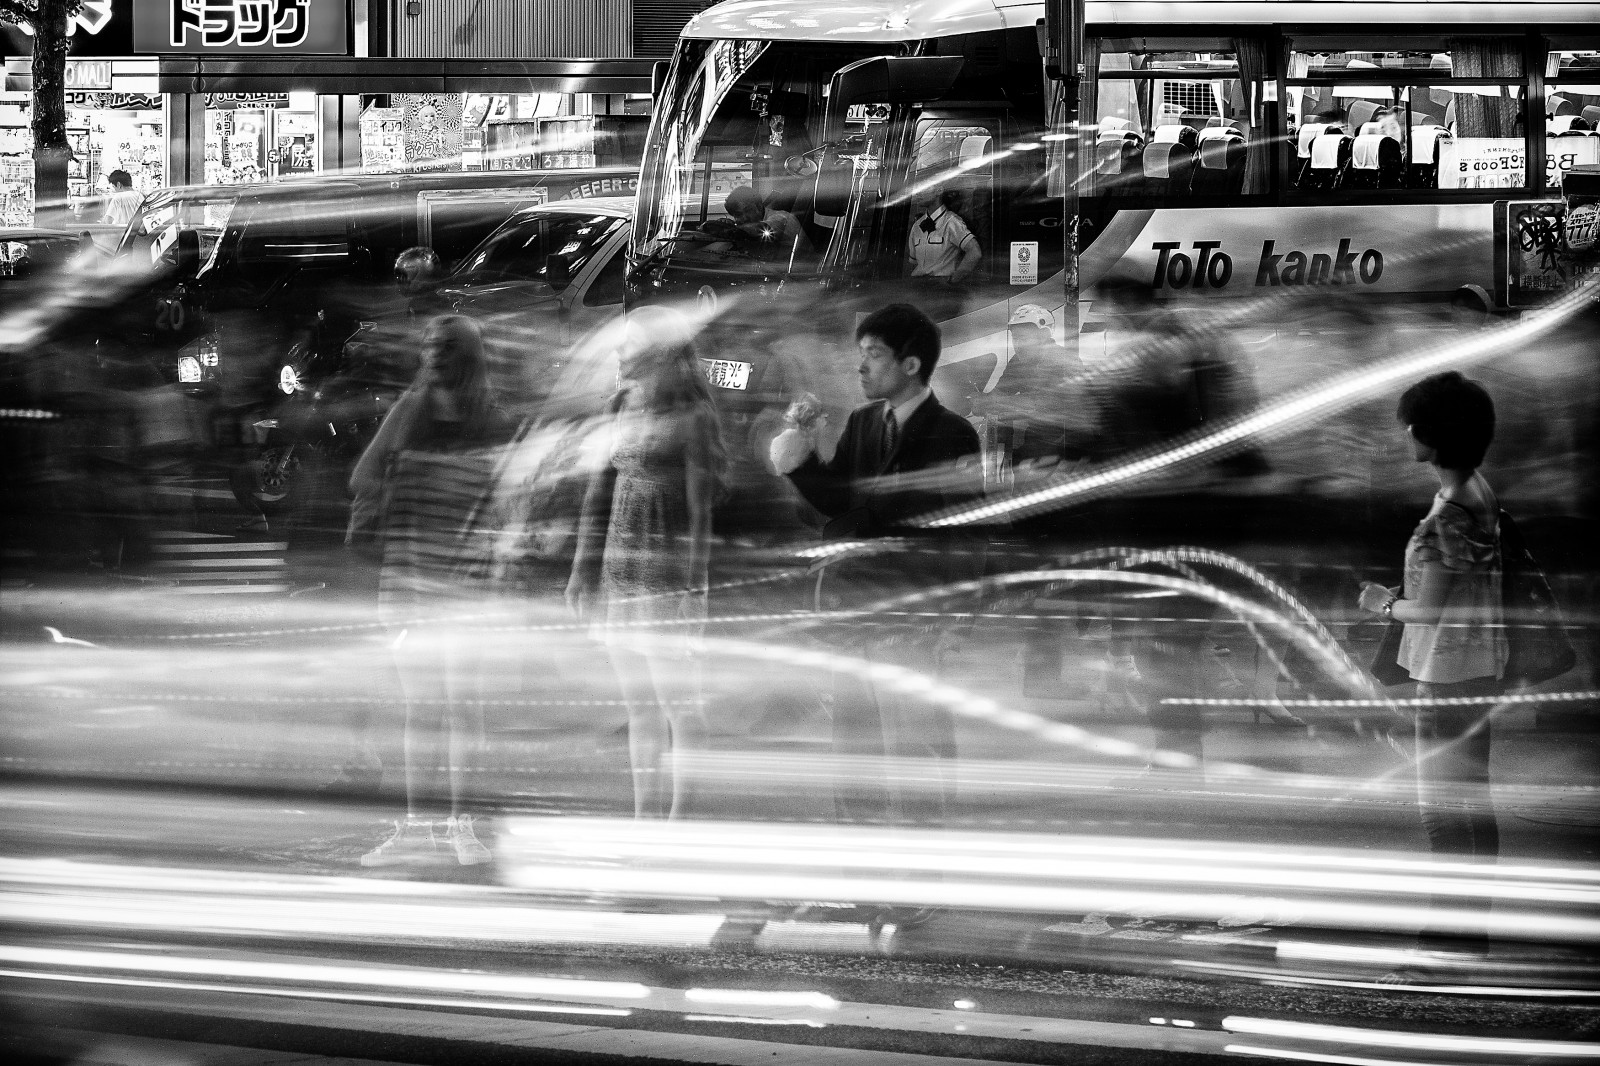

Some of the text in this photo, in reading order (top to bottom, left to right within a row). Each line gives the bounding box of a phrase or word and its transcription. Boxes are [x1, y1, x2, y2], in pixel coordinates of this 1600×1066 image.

[169, 0, 309, 47] ドラッグ
[77, 64, 110, 85] MALL
[1151, 238, 1384, 290] ToTo kanko
[155, 299, 185, 330] 20
